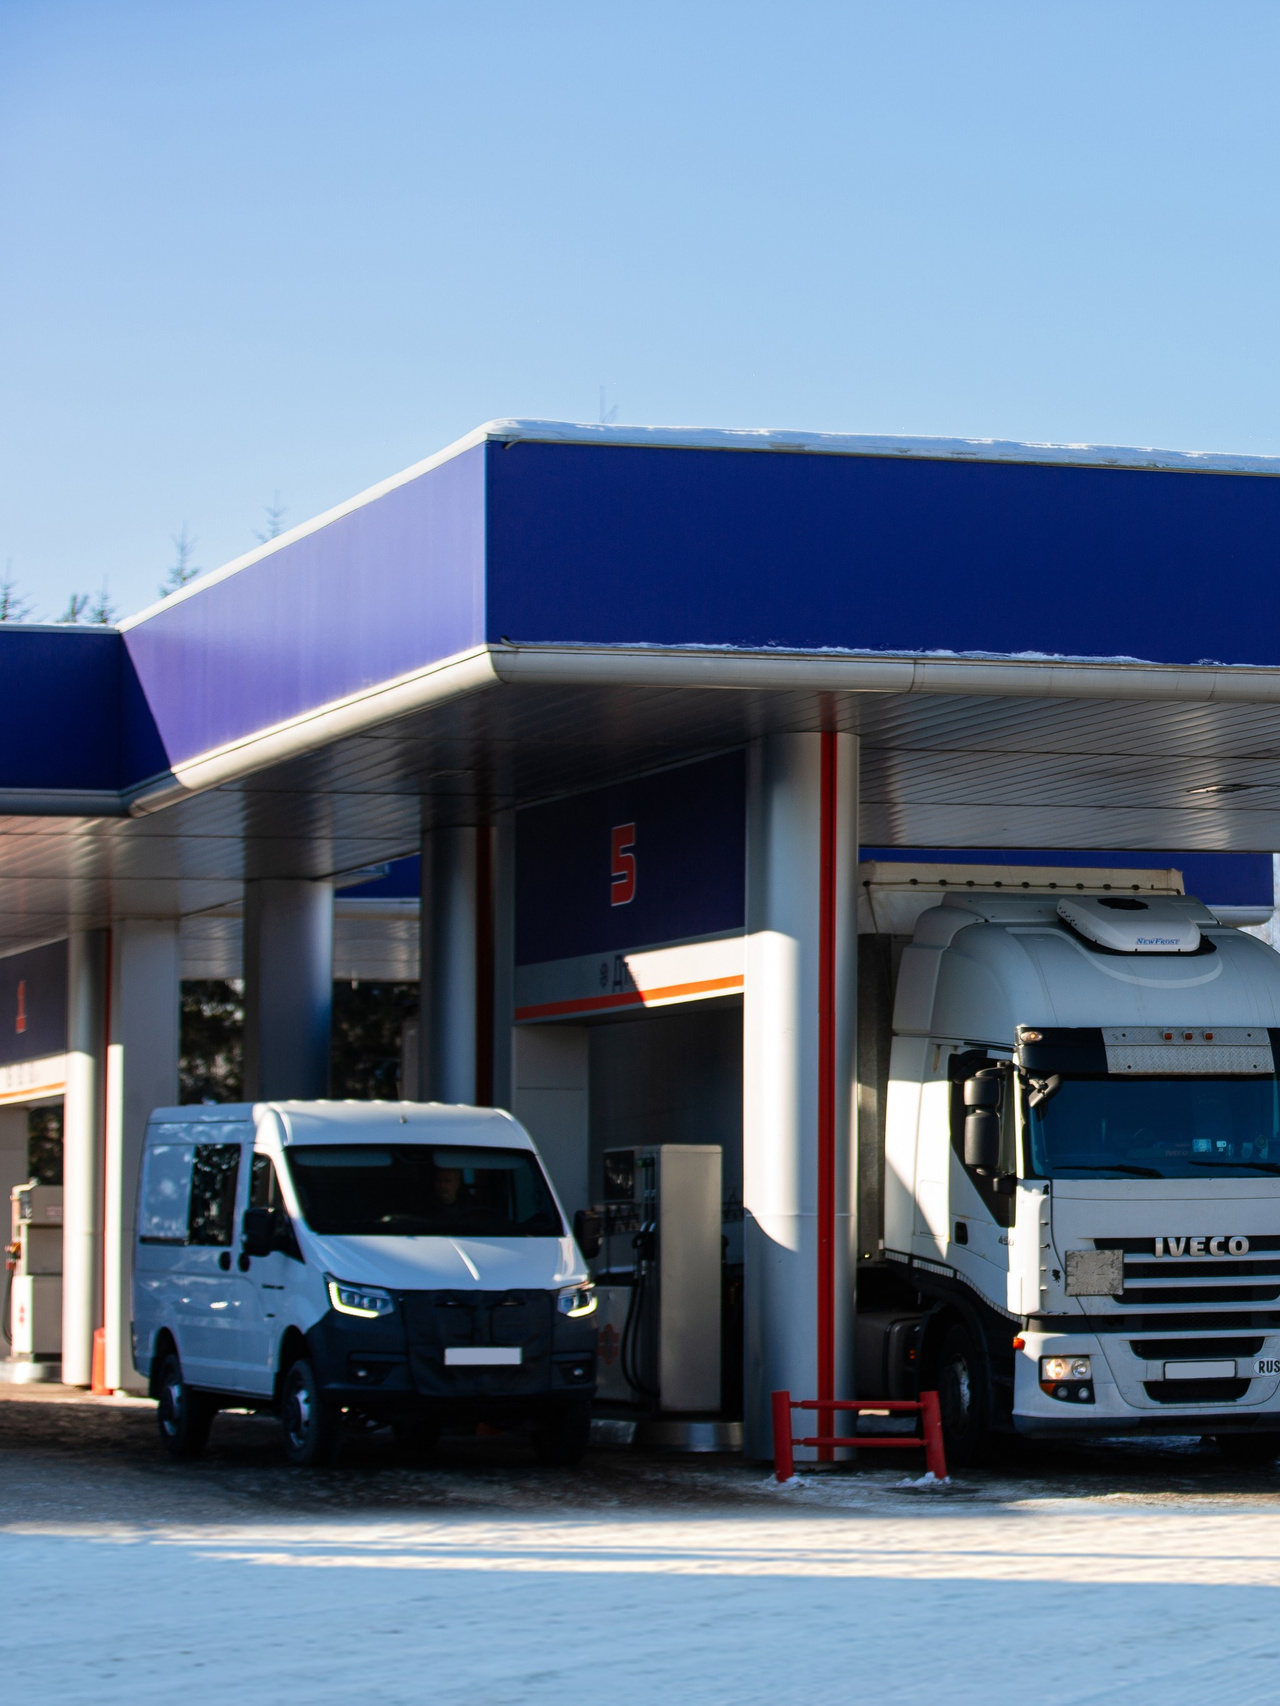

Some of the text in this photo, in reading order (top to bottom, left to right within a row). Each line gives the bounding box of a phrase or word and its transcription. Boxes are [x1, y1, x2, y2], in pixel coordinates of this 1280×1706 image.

[611, 822, 636, 907] 5
[1154, 1235, 1250, 1258] IVECO
[1258, 1360, 1280, 1373] RUS
